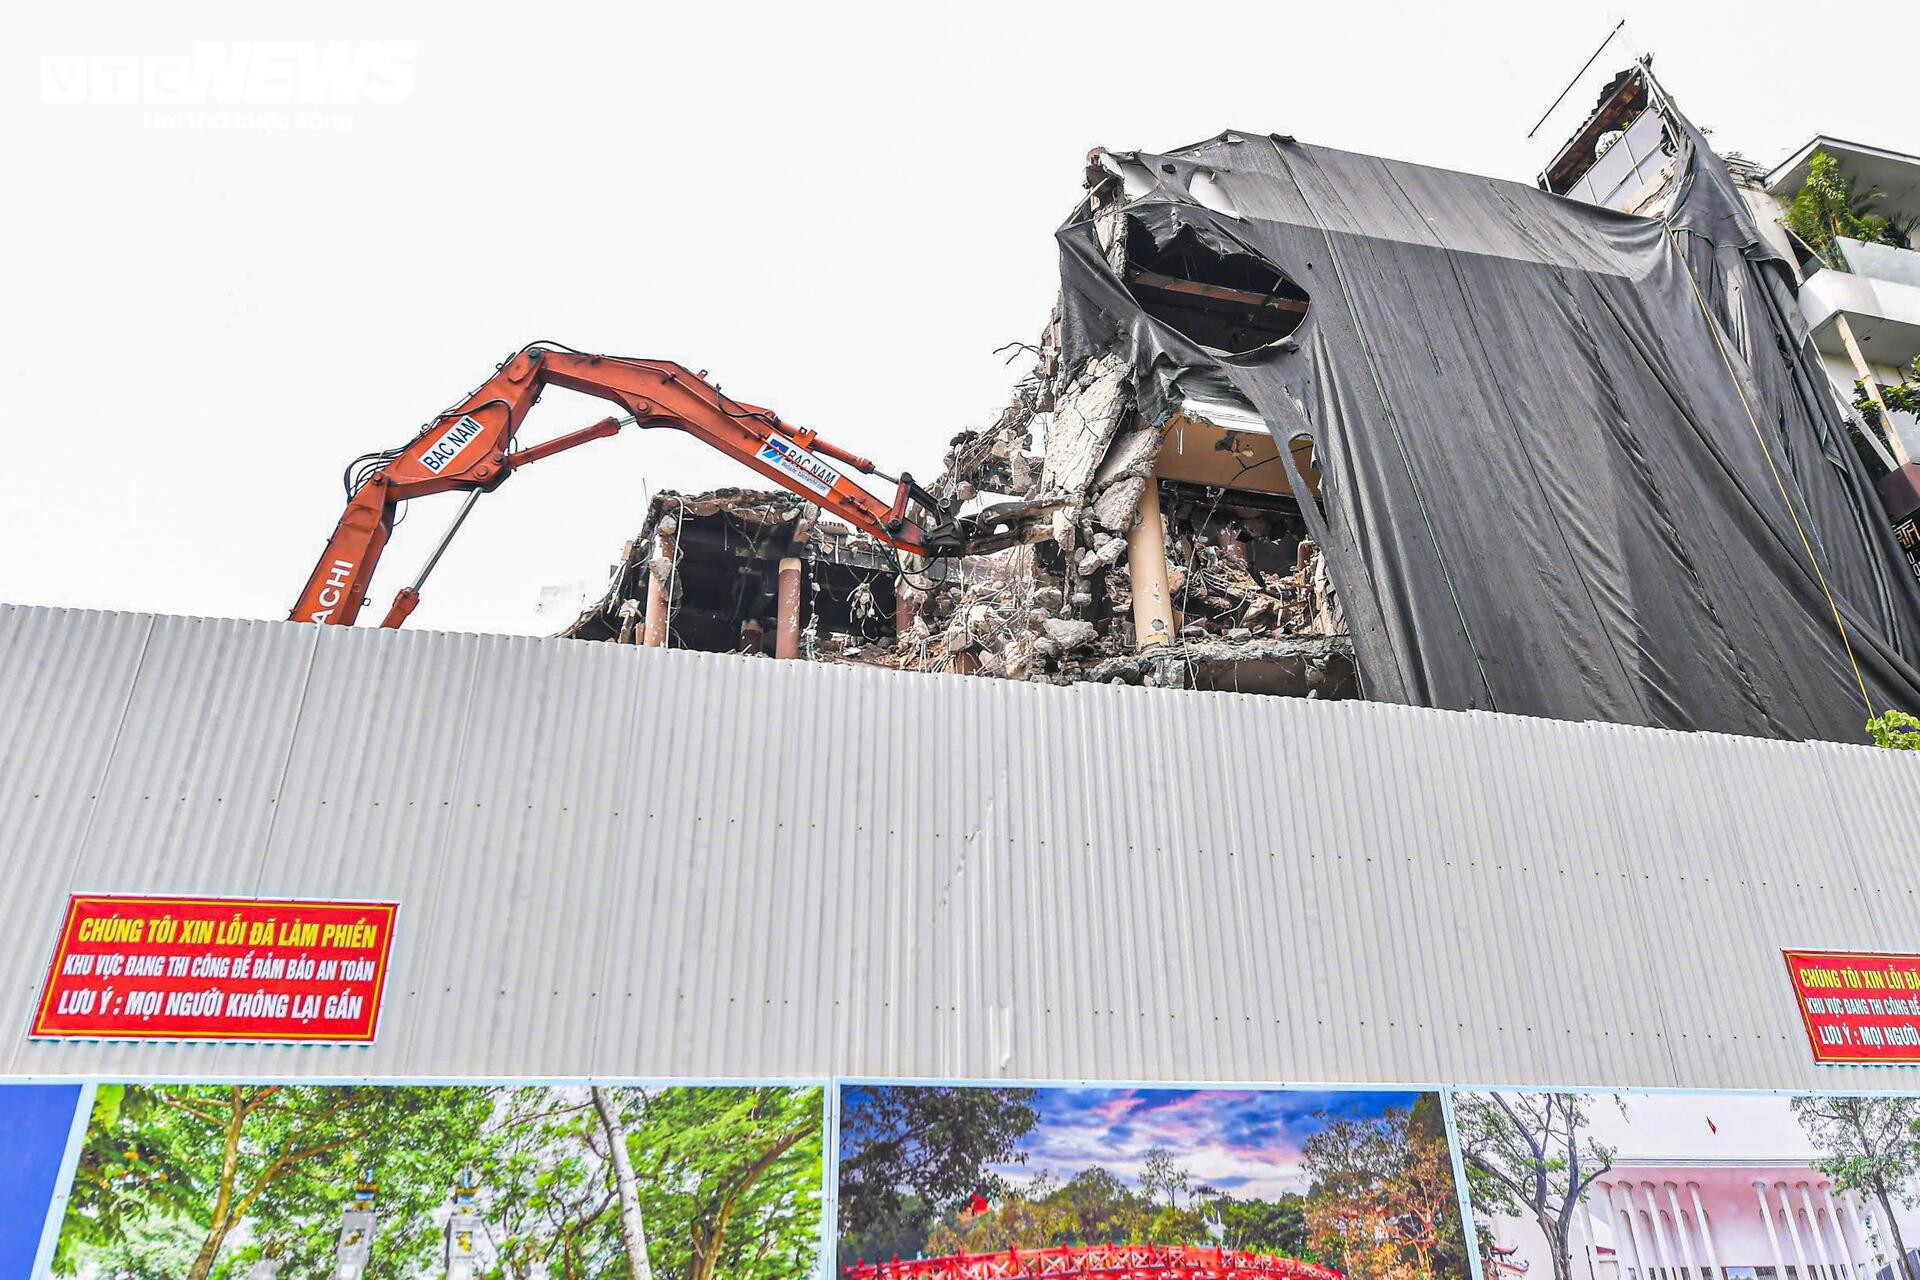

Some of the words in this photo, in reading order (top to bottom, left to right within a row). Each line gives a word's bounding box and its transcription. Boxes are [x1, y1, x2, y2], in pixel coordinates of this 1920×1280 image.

[422, 442, 455, 471] BAC
[446, 417, 481, 448] NAM
[787, 449, 812, 470] BAC
[810, 463, 837, 486] NAM
[77, 914, 145, 943] CHÚNG
[147, 915, 178, 944] TÔI
[178, 920, 215, 945] XIN
[215, 912, 248, 945] LỖI
[248, 918, 276, 946] ĐÃ
[277, 918, 320, 947] LÀM
[62, 954, 95, 976] KHU
[95, 953, 125, 980] VỰC
[124, 955, 165, 977] ĐANG
[166, 956, 191, 977] THI
[190, 953, 231, 978] CÔNG
[230, 950, 256, 979] ĐỂ
[251, 951, 286, 979] ĐẢM
[285, 952, 316, 980] BẢO
[315, 959, 339, 981] AN
[339, 957, 376, 982] TOÀN
[1799, 965, 1842, 988] CHÚNG
[1840, 966, 1863, 989] TÔI
[1861, 970, 1886, 989] XIN
[1883, 964, 1906, 989] LỖI
[57, 988, 97, 1015] LƯU
[123, 991, 165, 1021] MỌI
[164, 986, 225, 1017] NGƯỜI
[224, 988, 290, 1018] KHÔNG
[290, 994, 322, 1024] LẠI
[1805, 997, 1826, 1014] KHU
[1823, 996, 1844, 1018] VỰC
[1842, 998, 1870, 1015] ĐANG
[1867, 998, 1885, 1015] THI
[1883, 995, 1910, 1016] CÔNG
[1817, 1024, 1844, 1045] LƯU
[1858, 1026, 1885, 1050] MỌI
